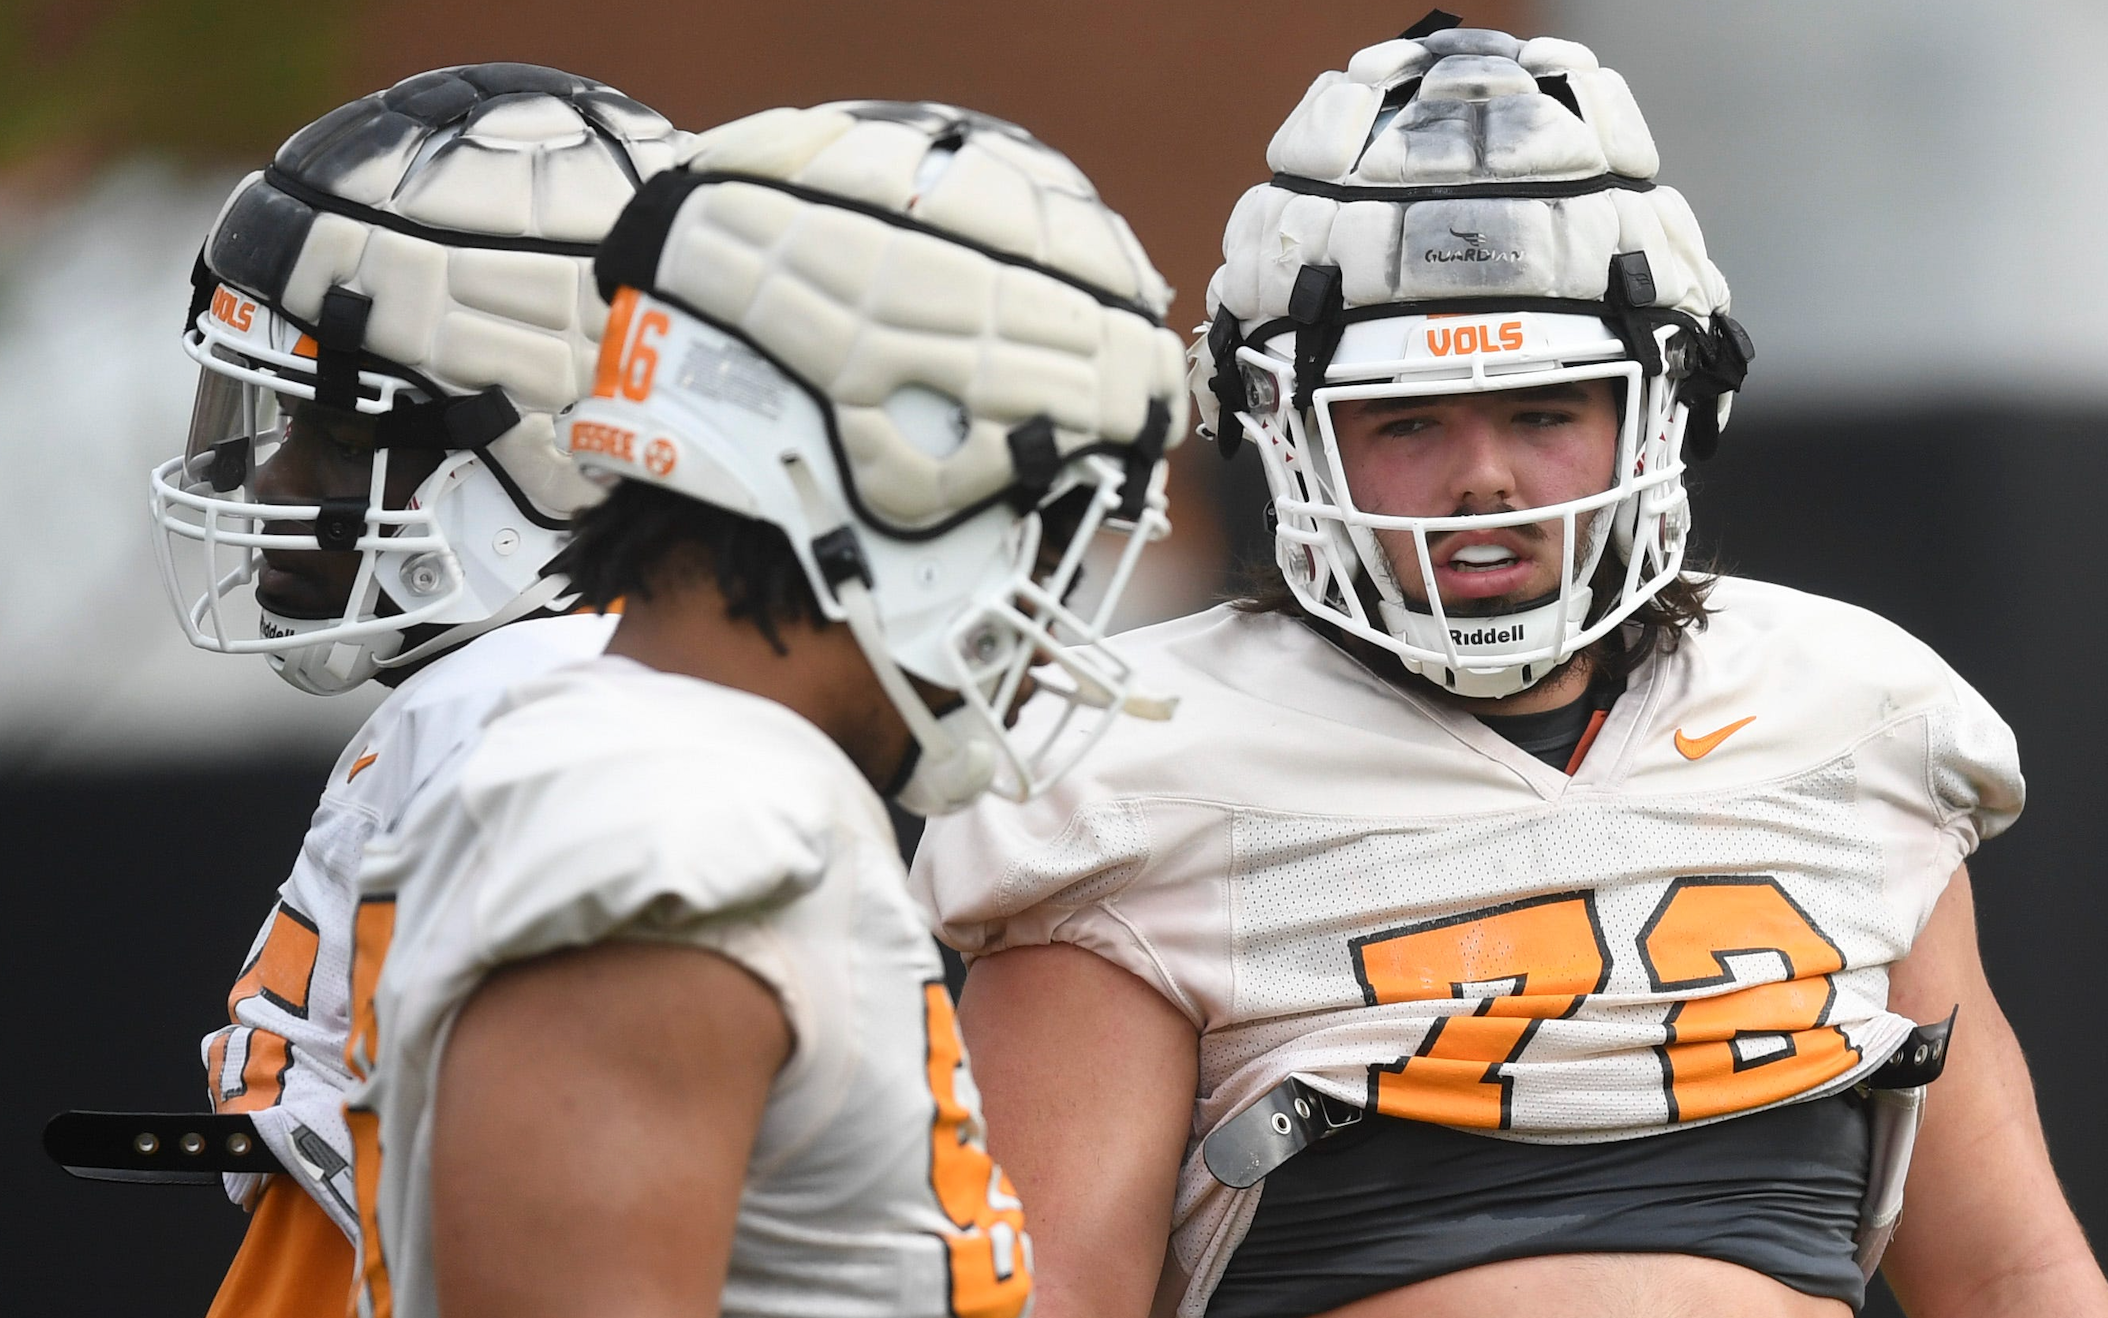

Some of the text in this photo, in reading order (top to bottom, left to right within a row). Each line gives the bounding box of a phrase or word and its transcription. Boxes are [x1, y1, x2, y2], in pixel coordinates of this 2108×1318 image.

[1425, 248, 1523, 263] GUARDIAN
[212, 286, 256, 333] VOLS
[1427, 321, 1523, 357] VOLS
[1450, 624, 1524, 646] Riddell
[1349, 874, 1864, 1130] 72
